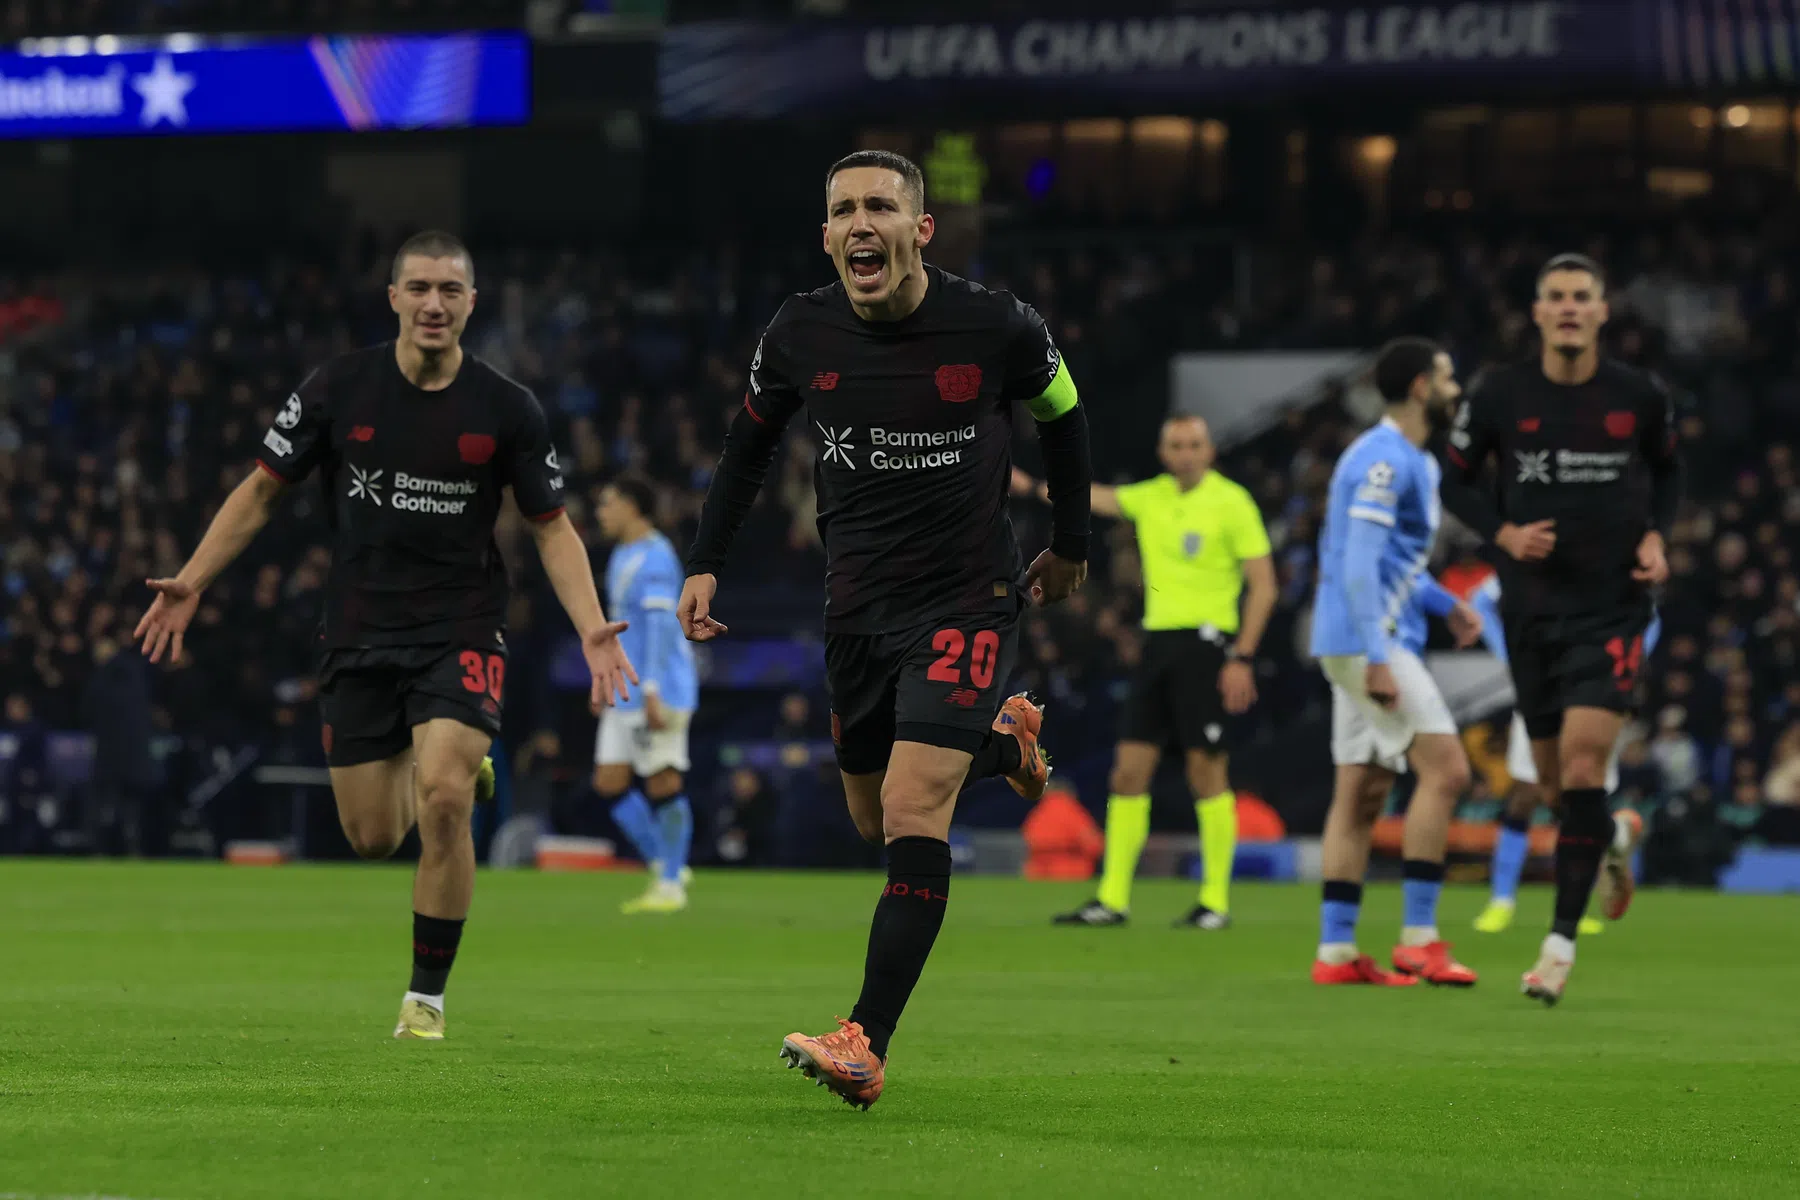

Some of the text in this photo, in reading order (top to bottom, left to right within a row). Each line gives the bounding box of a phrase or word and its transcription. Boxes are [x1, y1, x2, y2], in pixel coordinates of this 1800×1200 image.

[864, 3, 1557, 79] UEFA CHAMPIONS LEAGUE
[869, 424, 976, 447] Barmenia
[869, 449, 963, 470] Gothaer
[394, 471, 479, 495] Barmenia
[391, 491, 467, 514] Gothaer
[926, 628, 999, 689] 20
[458, 650, 505, 703] 30
